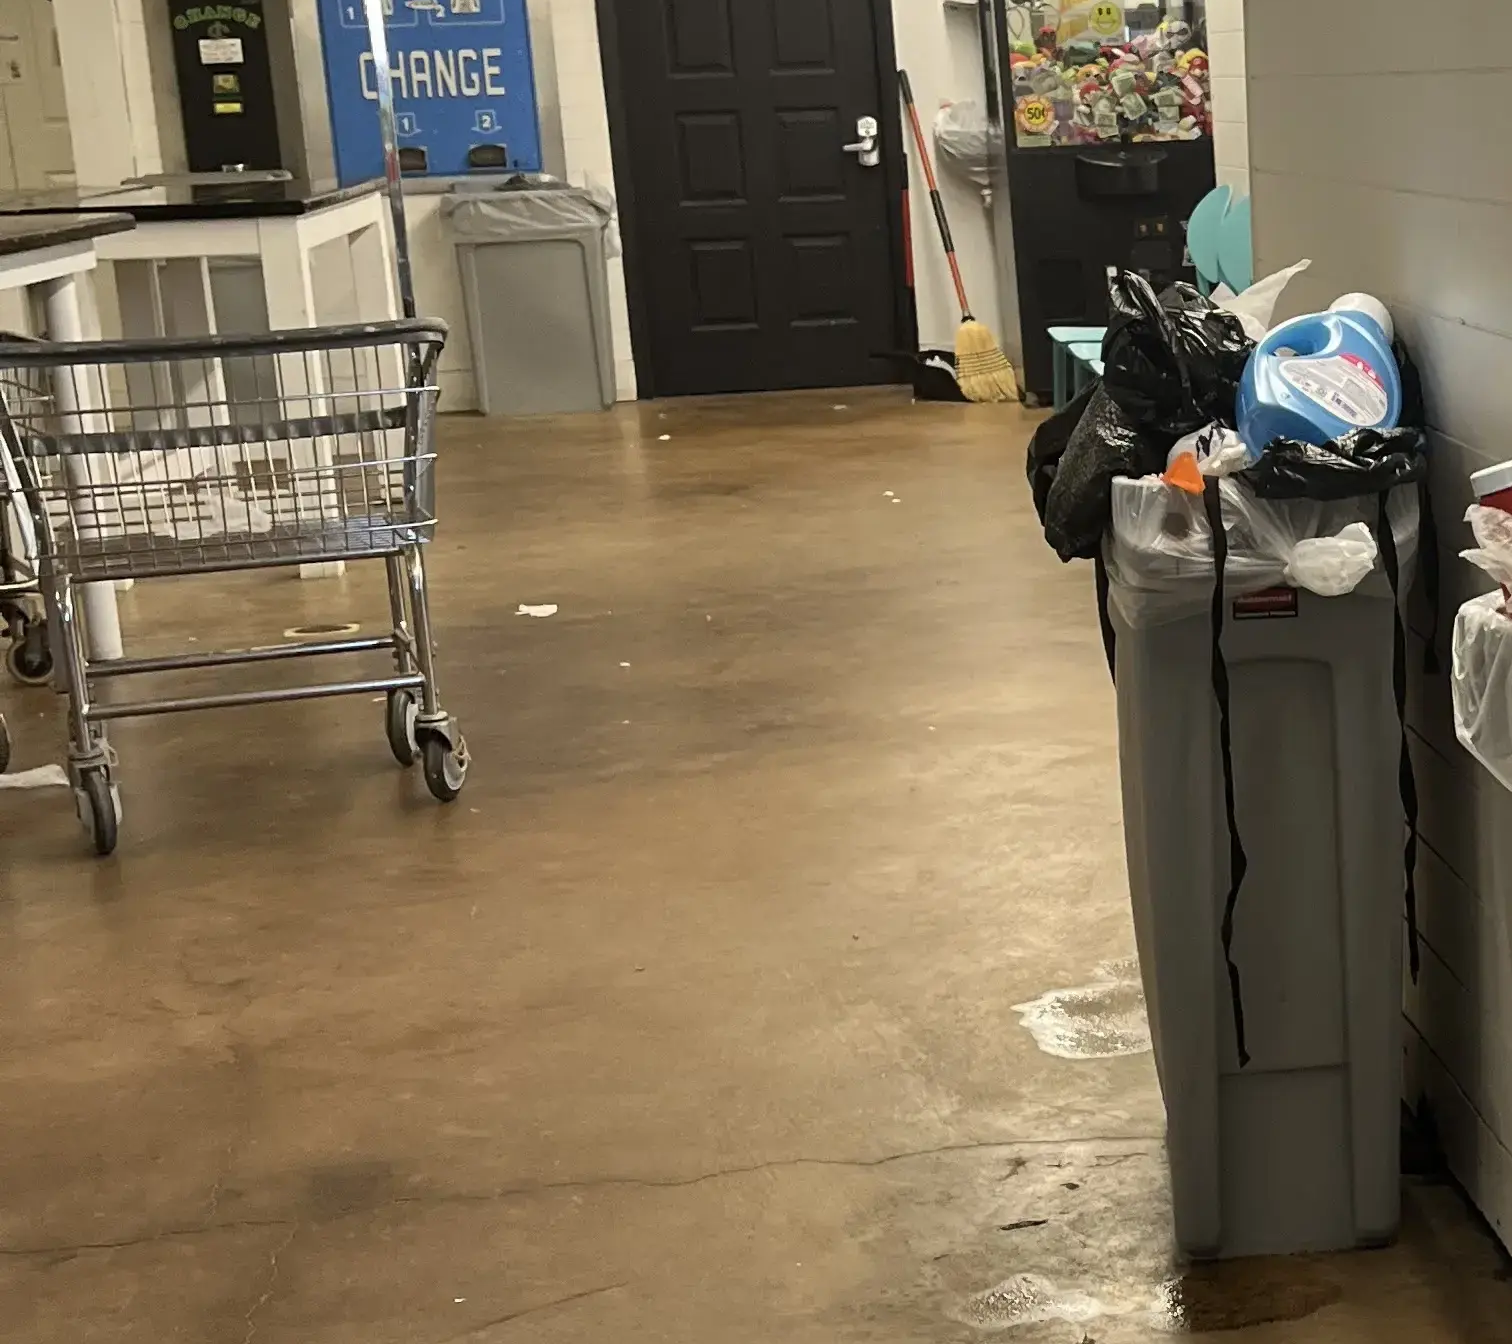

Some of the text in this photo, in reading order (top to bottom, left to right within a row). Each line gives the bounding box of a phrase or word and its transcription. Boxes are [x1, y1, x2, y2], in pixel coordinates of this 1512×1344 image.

[347, 6, 355, 20] 1
[359, 48, 505, 100] CHANGE
[401, 117, 409, 131] 1
[482, 114, 491, 128] 2
